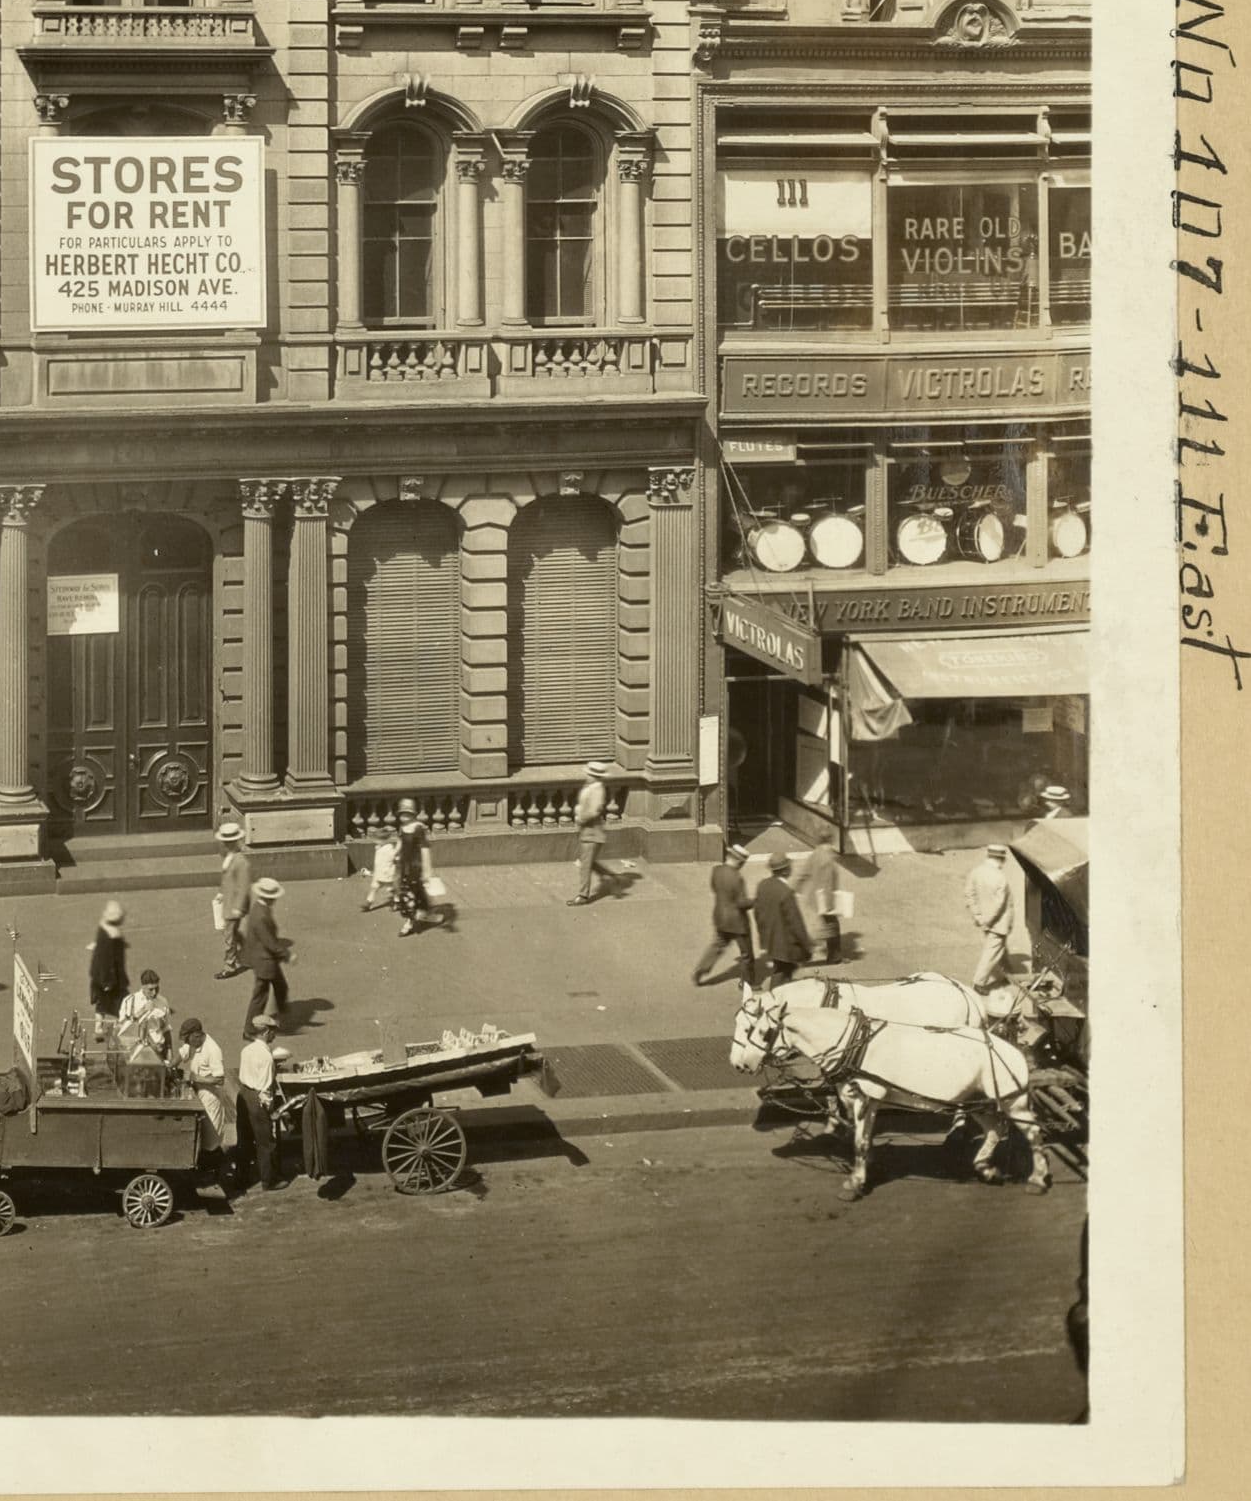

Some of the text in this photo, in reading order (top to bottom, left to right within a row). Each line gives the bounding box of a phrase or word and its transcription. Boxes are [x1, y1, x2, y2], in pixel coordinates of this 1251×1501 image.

[50, 155, 244, 194] STORES
[66, 200, 232, 230] FOR RENT
[904, 216, 1021, 240] RARE OLD
[59, 235, 232, 249] FOR PARTICULARS APPLY TO
[726, 234, 860, 263] CELLOS
[45, 254, 139, 276] HERBERT
[148, 252, 209, 274] HECHT
[901, 247, 1026, 276] VIOLINS
[58, 278, 238, 298] 425 MADISON AVE.
[72, 303, 103, 313] PHONE
[114, 302, 155, 313] MURRAY
[159, 301, 183, 312] HILL
[191, 300, 228, 311] 4444
[742, 373, 868, 399] RECORDS
[898, 367, 1046, 399] VICTROLAS
[1174, 479, 1251, 690] East
[836, 600, 890, 621] YORK
[897, 596, 953, 620] BAND
[726, 611, 804, 671] VICTROLAS
